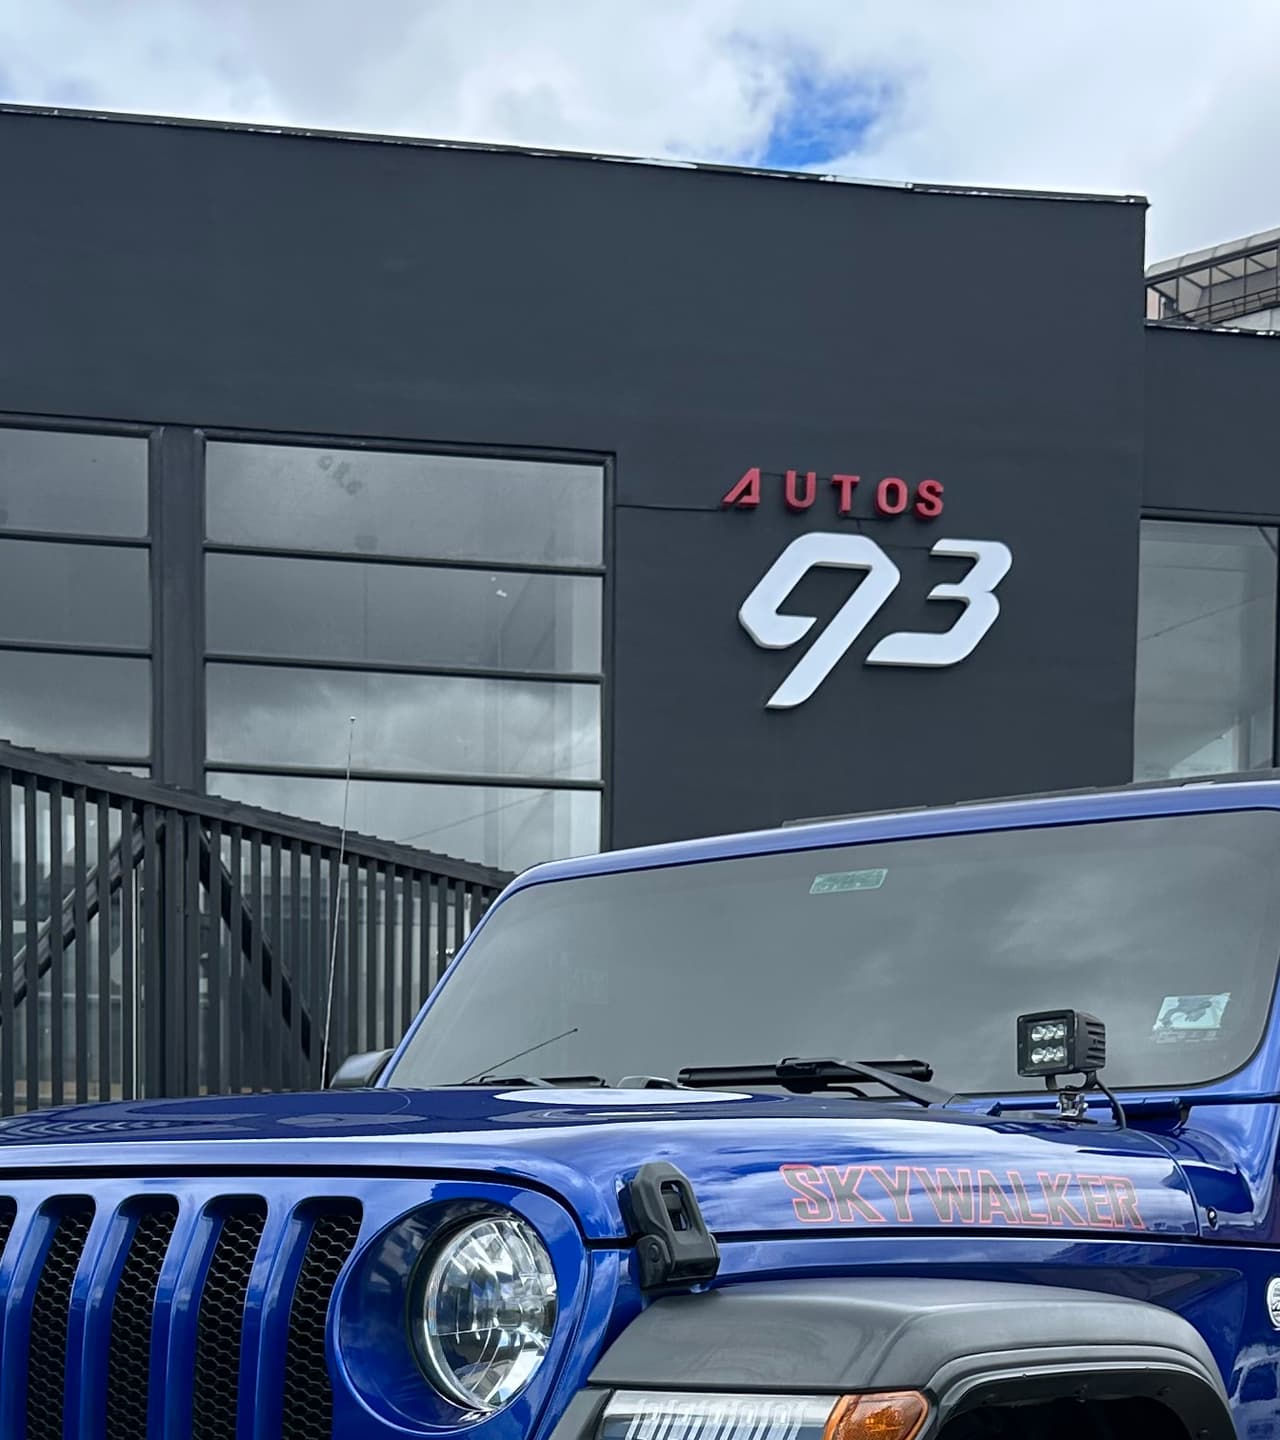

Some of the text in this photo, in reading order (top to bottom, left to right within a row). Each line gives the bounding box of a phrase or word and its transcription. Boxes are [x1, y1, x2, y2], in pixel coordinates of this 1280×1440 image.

[722, 467, 945, 520] AUTOS
[737, 532, 1013, 710] 93
[780, 1163, 1147, 1231] SKYWALKER
